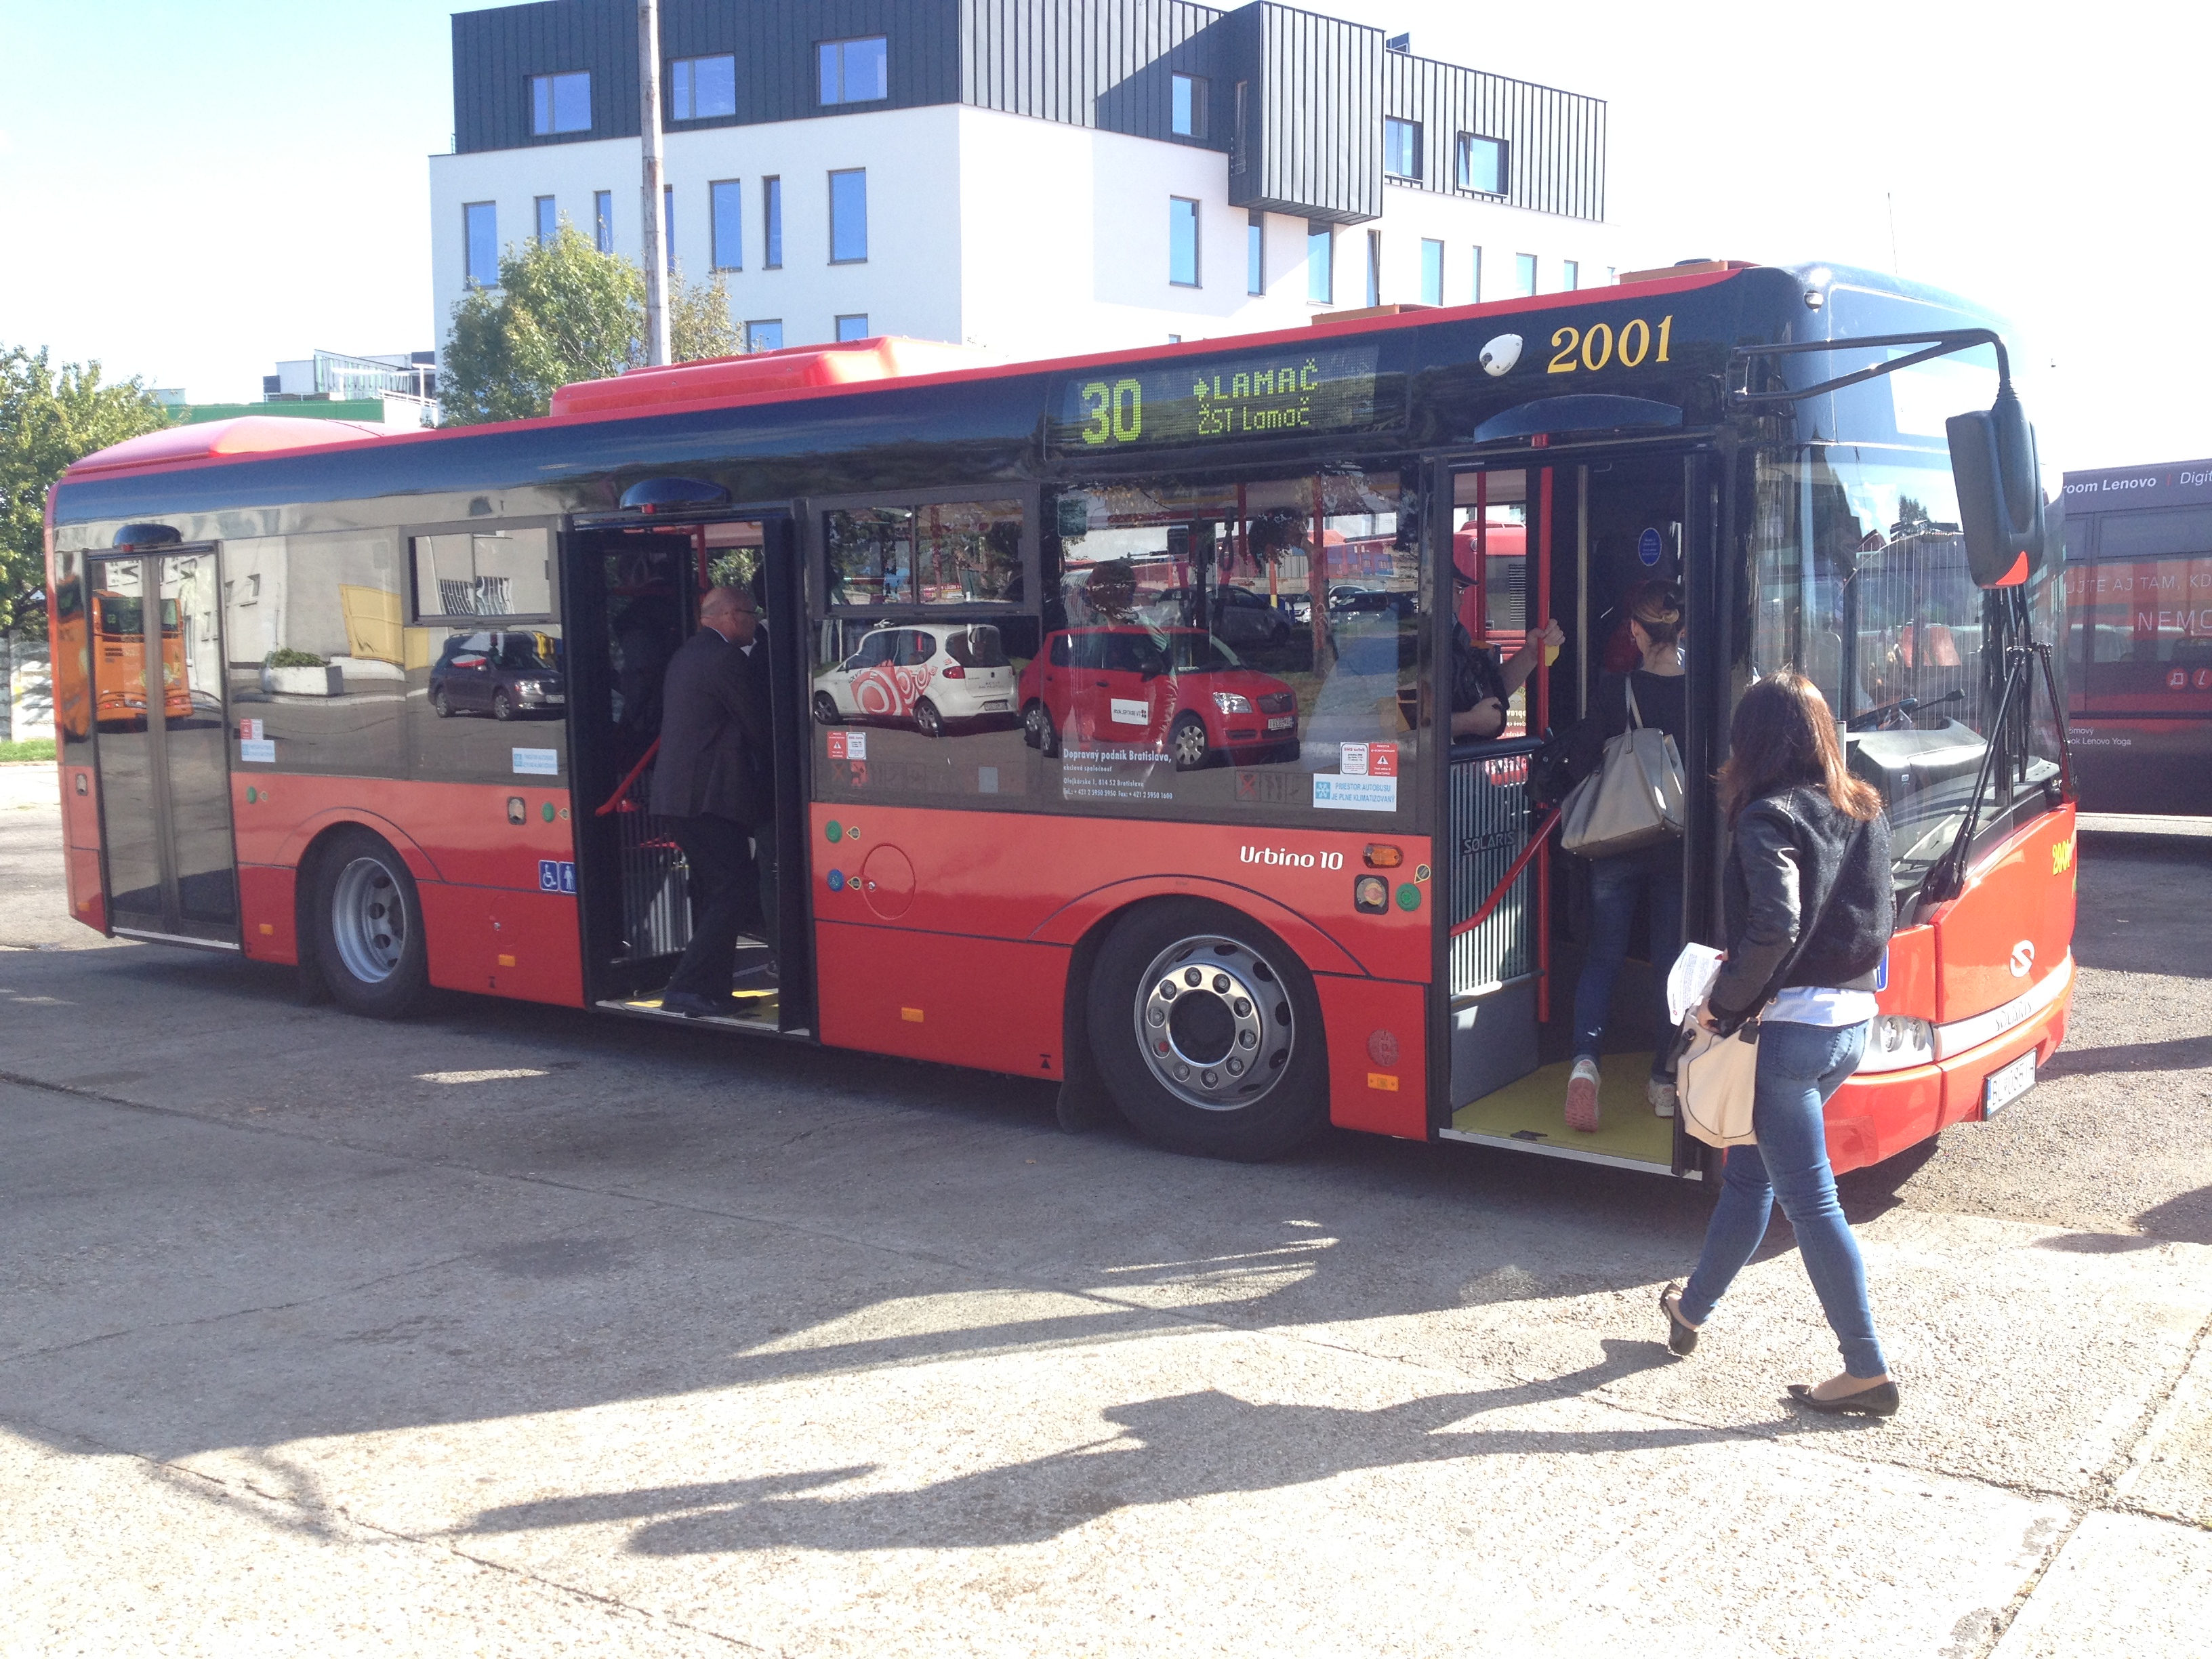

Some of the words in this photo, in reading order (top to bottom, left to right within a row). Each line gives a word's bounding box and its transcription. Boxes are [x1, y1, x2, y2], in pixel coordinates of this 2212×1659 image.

[1547, 314, 1673, 373] 2001
[1214, 358, 1318, 400] LAMAČ
[1082, 379, 1141, 444] 30
[1198, 403, 1233, 434] ŽST
[1243, 396, 1309, 431] Lamač
[2102, 477, 2156, 491] Lenovo
[2112, 577, 2133, 592] AJ
[2139, 576, 2181, 591] TAM,
[2082, 737, 2110, 745] Lenovo
[2112, 737, 2131, 746] Yoga
[1063, 748, 1099, 762] Dopravný
[1101, 750, 1127, 762] podnik
[1129, 750, 1172, 763] Bratislava,
[1117, 779, 1144, 787] Bratislava
[1335, 782, 1360, 791] PRIESTOR
[1361, 783, 1391, 792] AUTOBUSU
[1464, 831, 1515, 853] SOLARIS
[1240, 845, 1315, 867] Urbino
[1319, 851, 1343, 870] 10
